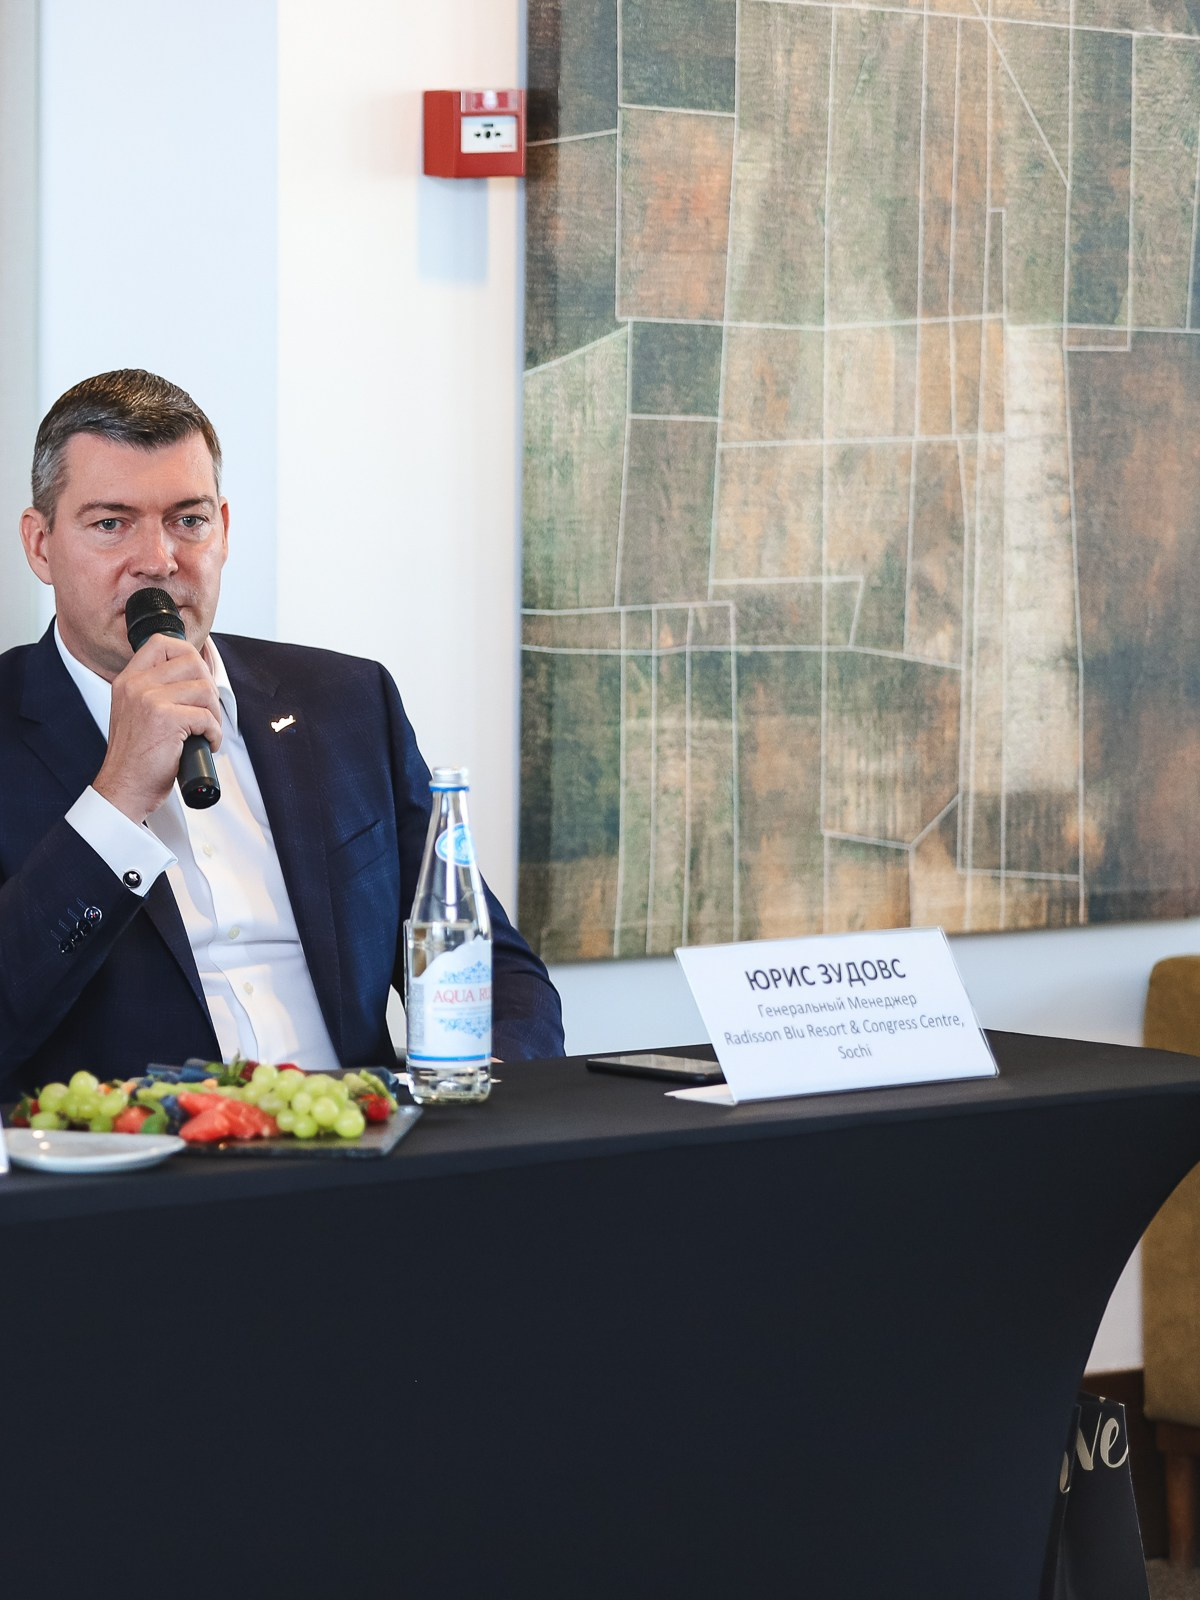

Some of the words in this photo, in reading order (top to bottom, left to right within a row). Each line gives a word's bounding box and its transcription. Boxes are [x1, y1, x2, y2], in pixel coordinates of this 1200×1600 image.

[745, 965, 816, 991] ЮРИС
[817, 958, 906, 988] ЗУДОВС
[433, 988, 476, 1004] AQUA
[757, 998, 846, 1019] Генеральный
[847, 992, 918, 1011] Менеджер
[724, 1028, 783, 1046] Radisson
[784, 1025, 805, 1040] Blu
[808, 1022, 848, 1037] Resort
[850, 1020, 861, 1034] &
[863, 1016, 918, 1034] Congress
[919, 1012, 965, 1029] Centre,
[838, 1043, 873, 1060] Sochi
